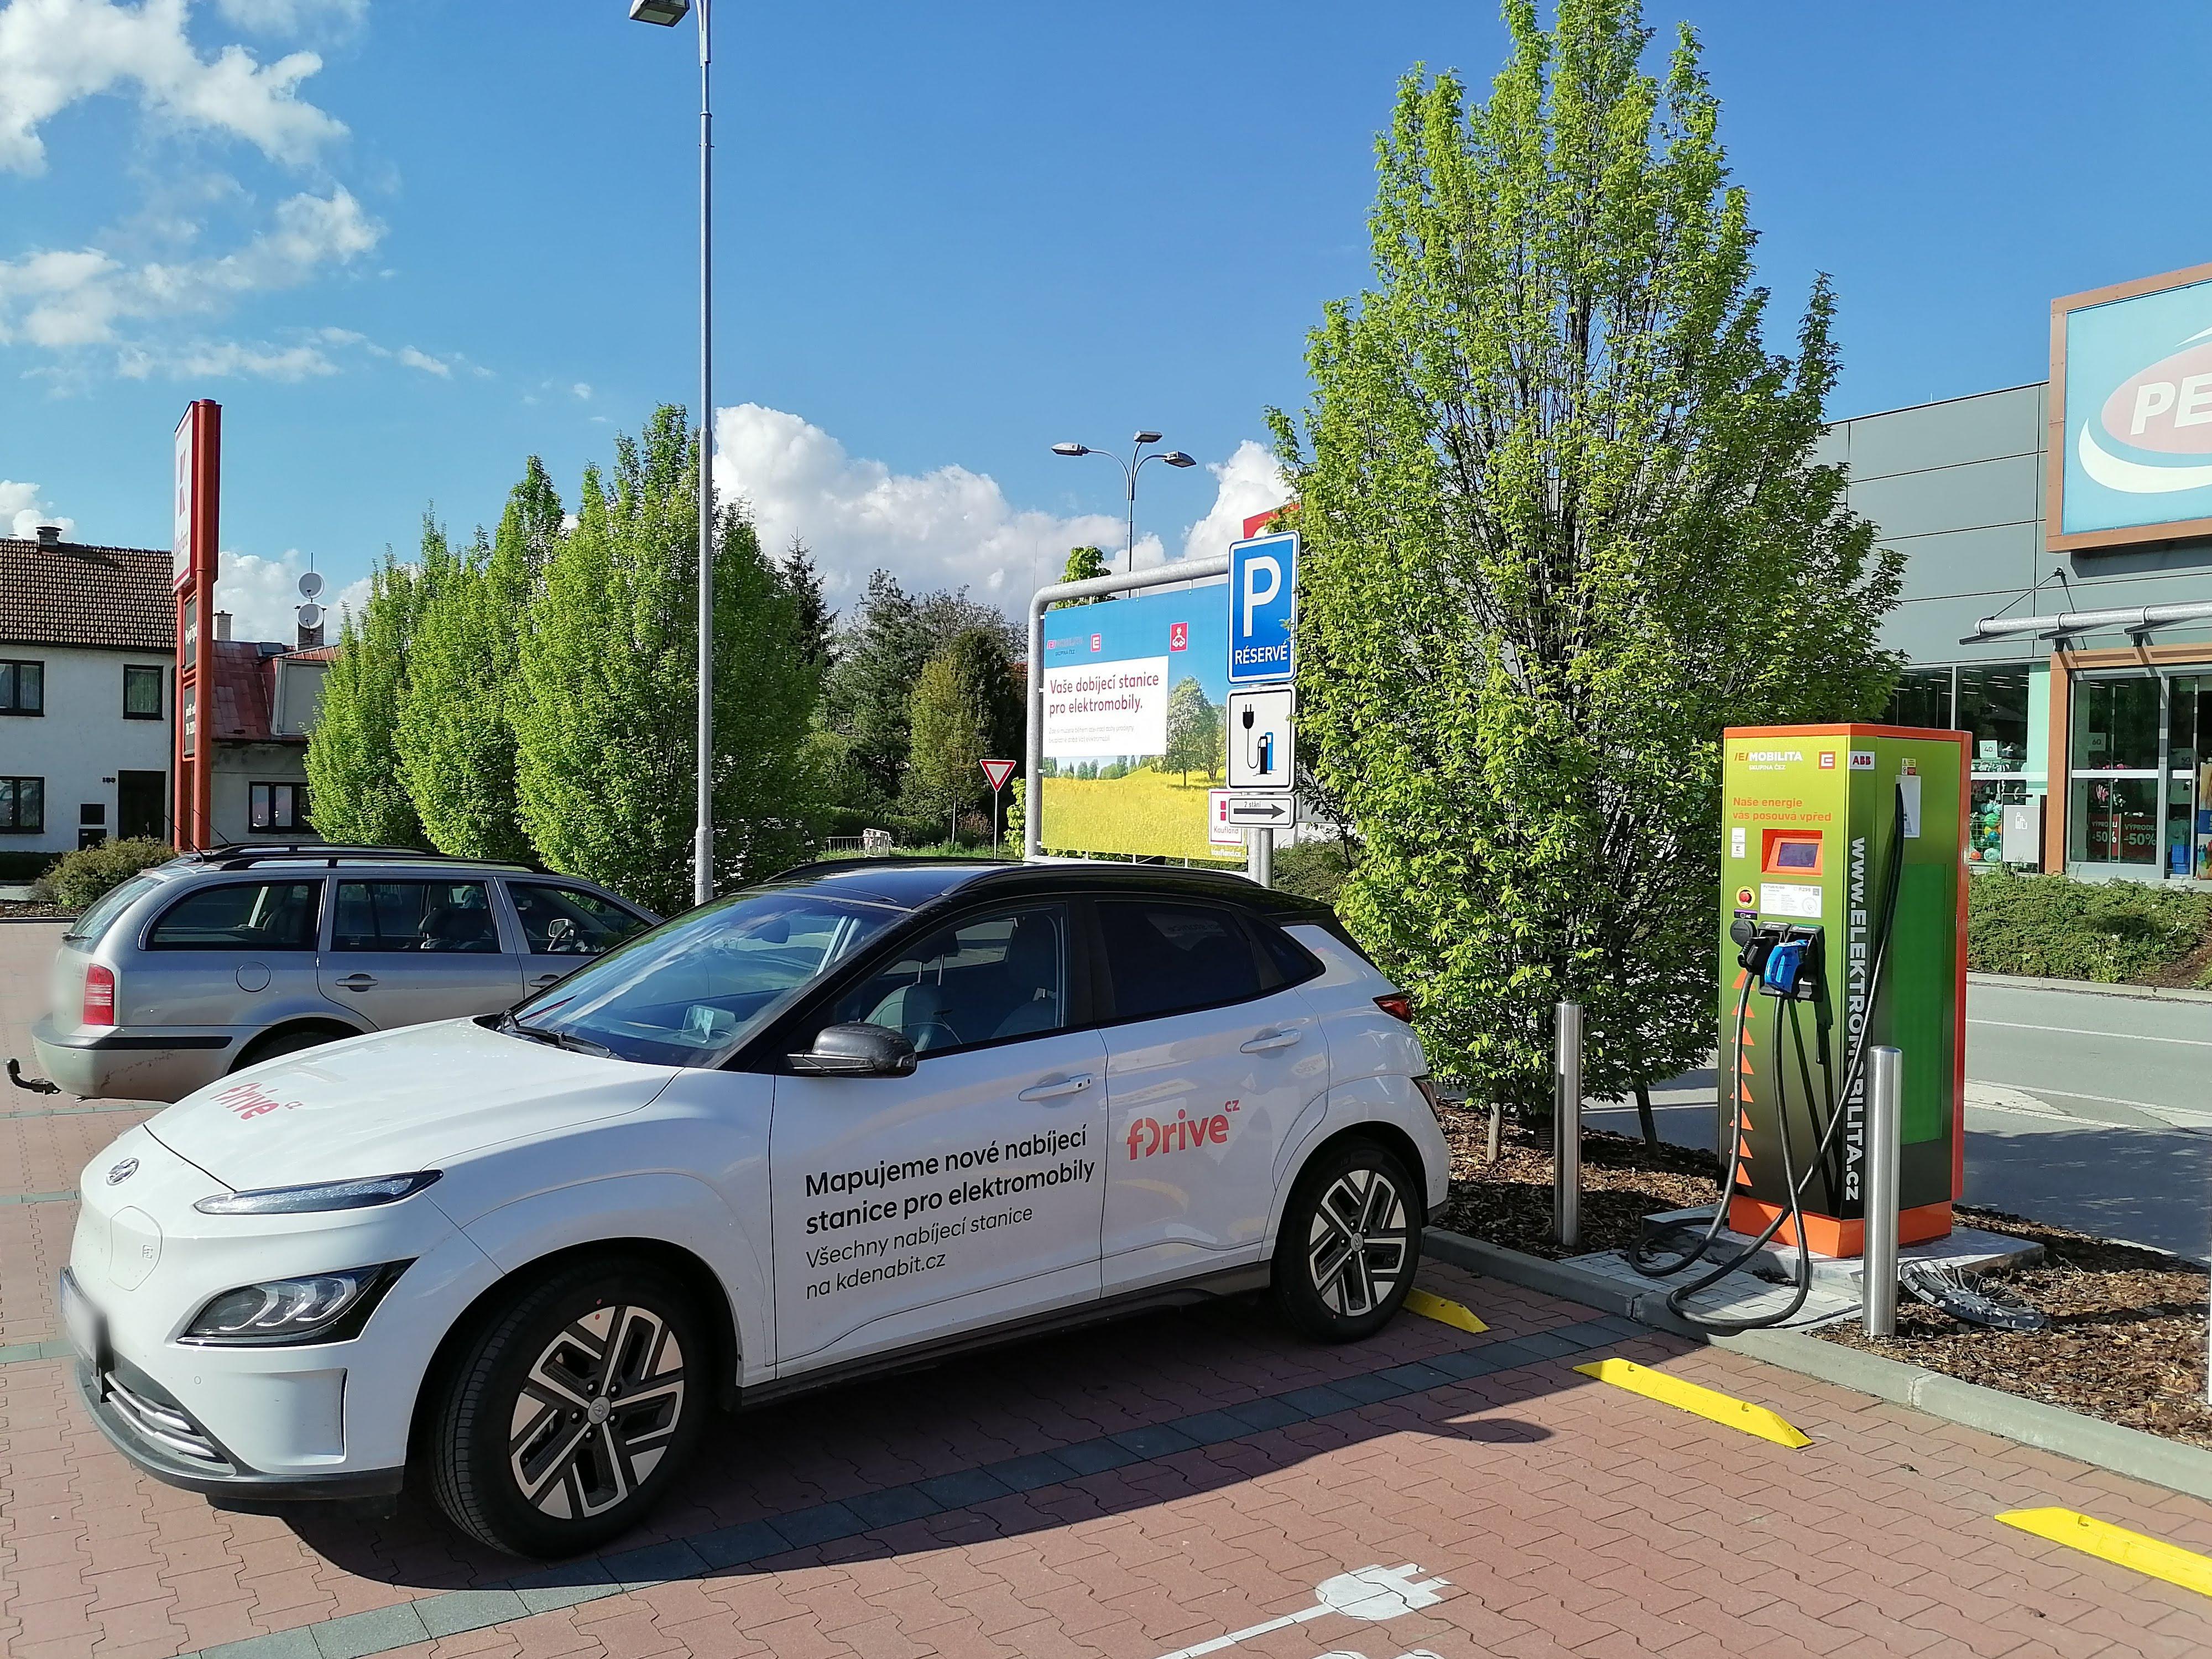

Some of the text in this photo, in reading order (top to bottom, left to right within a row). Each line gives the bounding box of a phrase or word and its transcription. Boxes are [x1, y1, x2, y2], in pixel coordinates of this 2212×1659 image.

[2130, 372, 2212, 435] PE
[1243, 556, 1281, 638] P
[1235, 641, 1288, 665] RÉSERVÉ
[1050, 671, 1159, 695] Vaše dobíjecí stanice
[1050, 693, 1143, 718] pro elektromobily.
[1853, 755, 1871, 765] ABB
[1733, 797, 1803, 808] Naše energie
[1733, 811, 1832, 823] vás posouvá vpřed
[2124, 833, 2157, 846] -50%
[805, 1124, 1087, 1198] Mapujeme nové nabíjecí
[805, 1159, 1095, 1234] stanice pro elektromobily
[805, 1207, 1034, 1269] Všechny nabíjecí stanice
[806, 1253, 946, 1300] na kdenabit.cz
